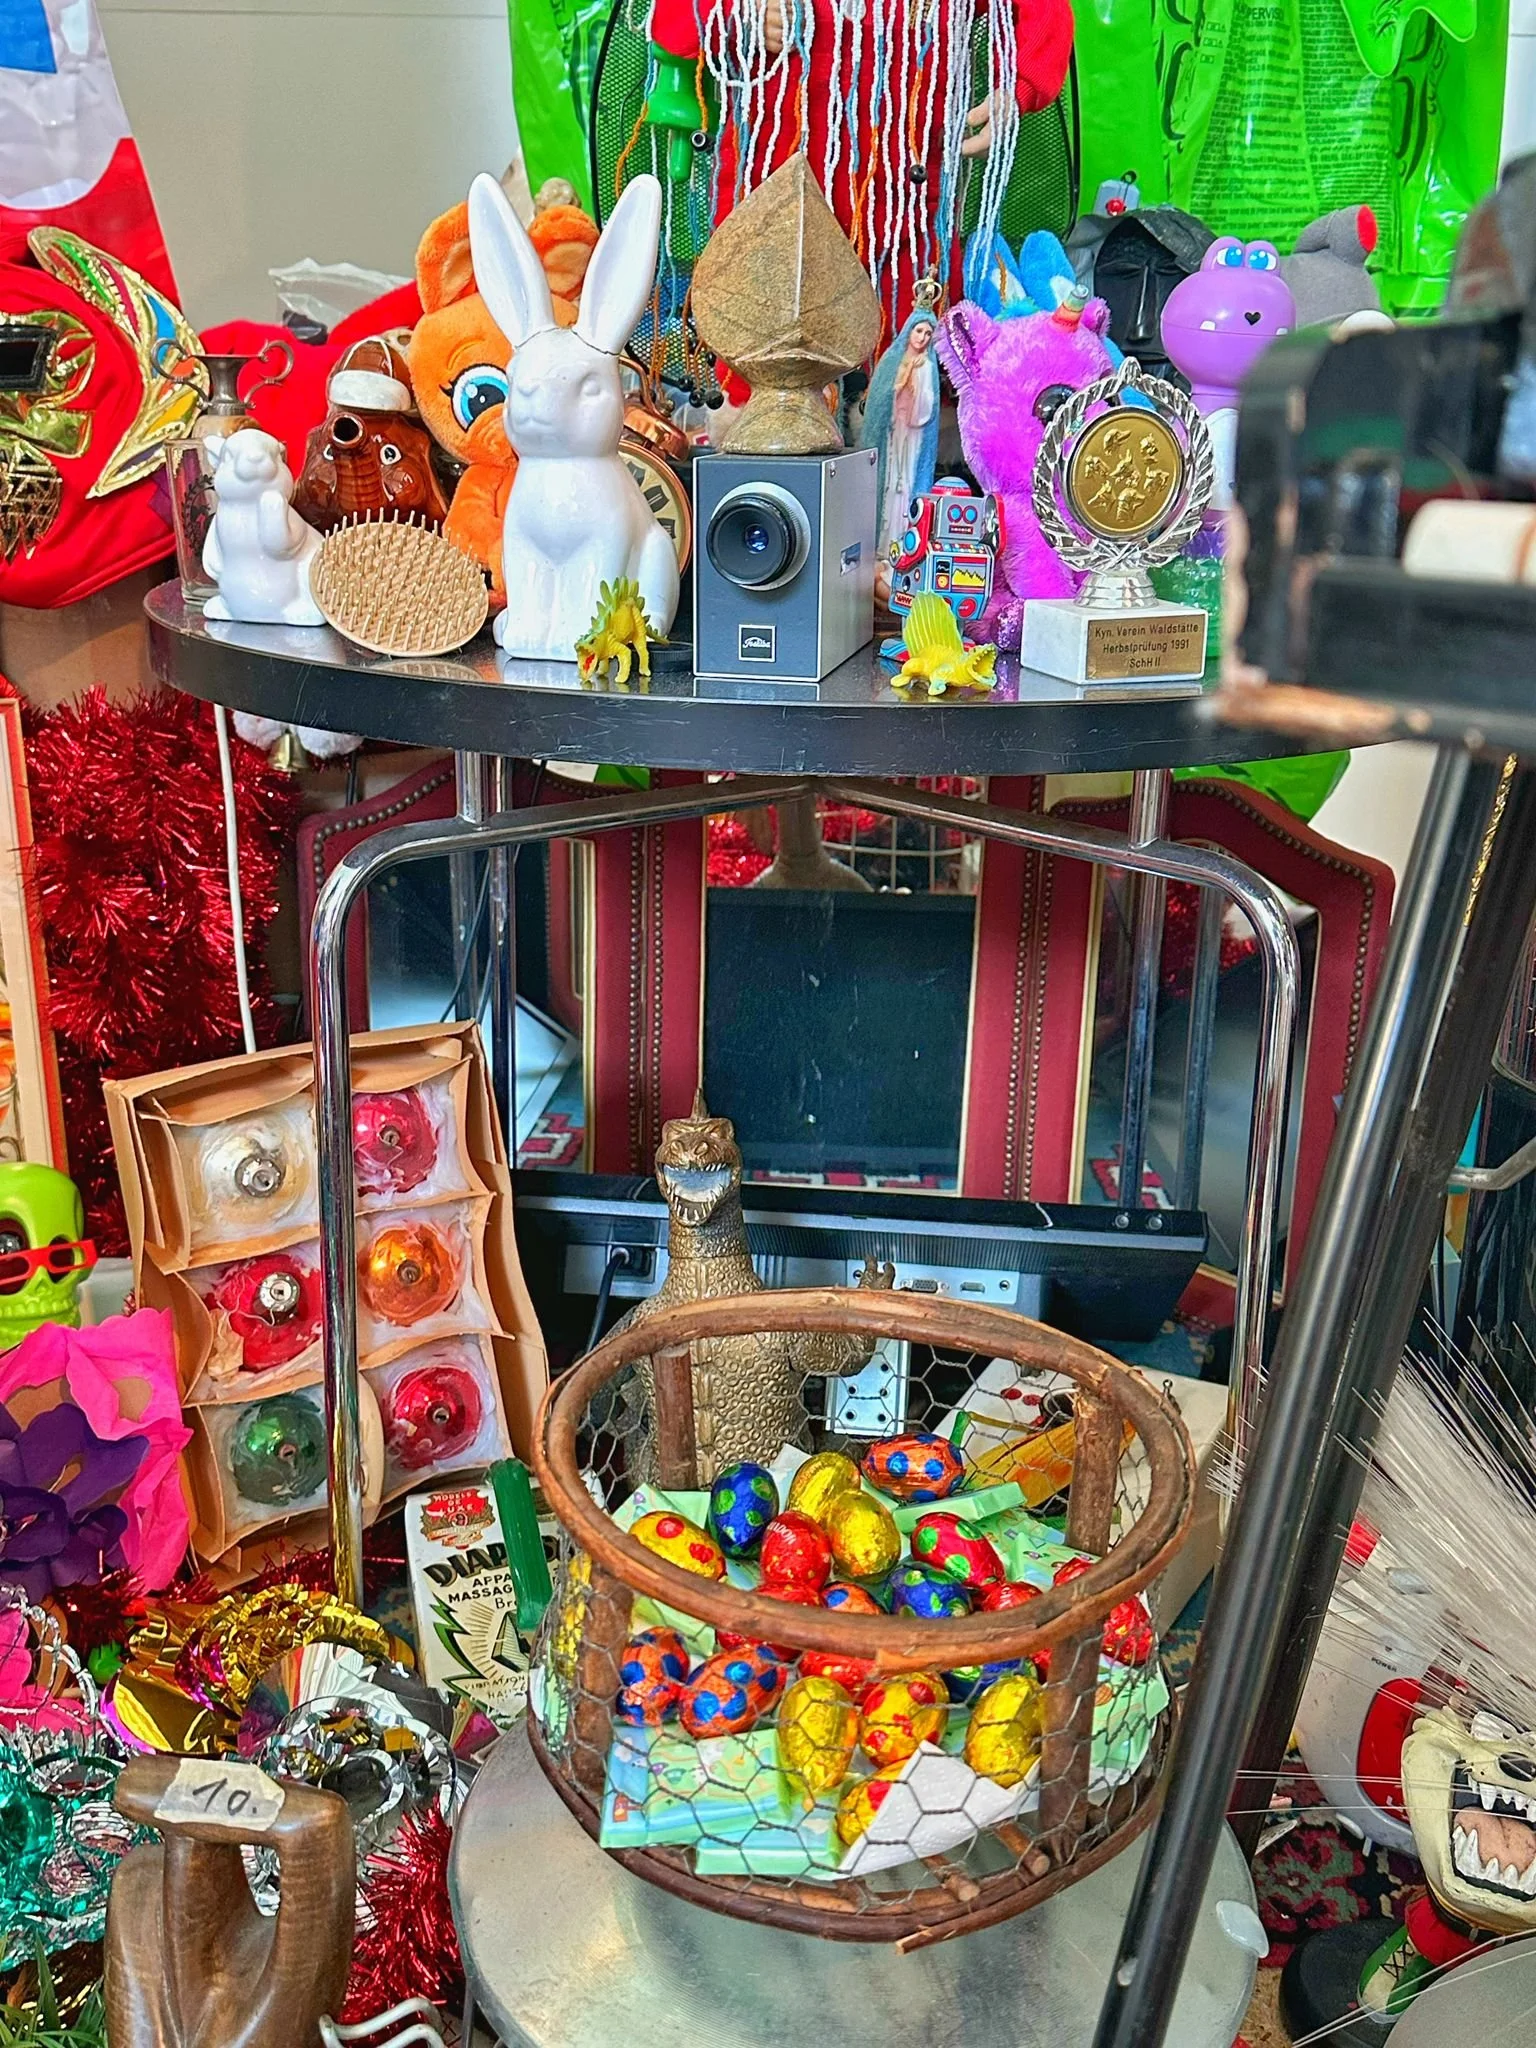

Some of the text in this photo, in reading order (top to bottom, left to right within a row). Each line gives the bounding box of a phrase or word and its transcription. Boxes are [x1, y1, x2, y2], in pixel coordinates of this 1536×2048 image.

[1095, 623, 1199, 640] Kyn. Verein Waldstätte
[1103, 639, 1189, 654] Herbstprüfung 1991
[1129, 657, 1153, 669] SchH
[448, 1585, 513, 1603] MASSAG
[1371, 1657, 1397, 1673] POWER
